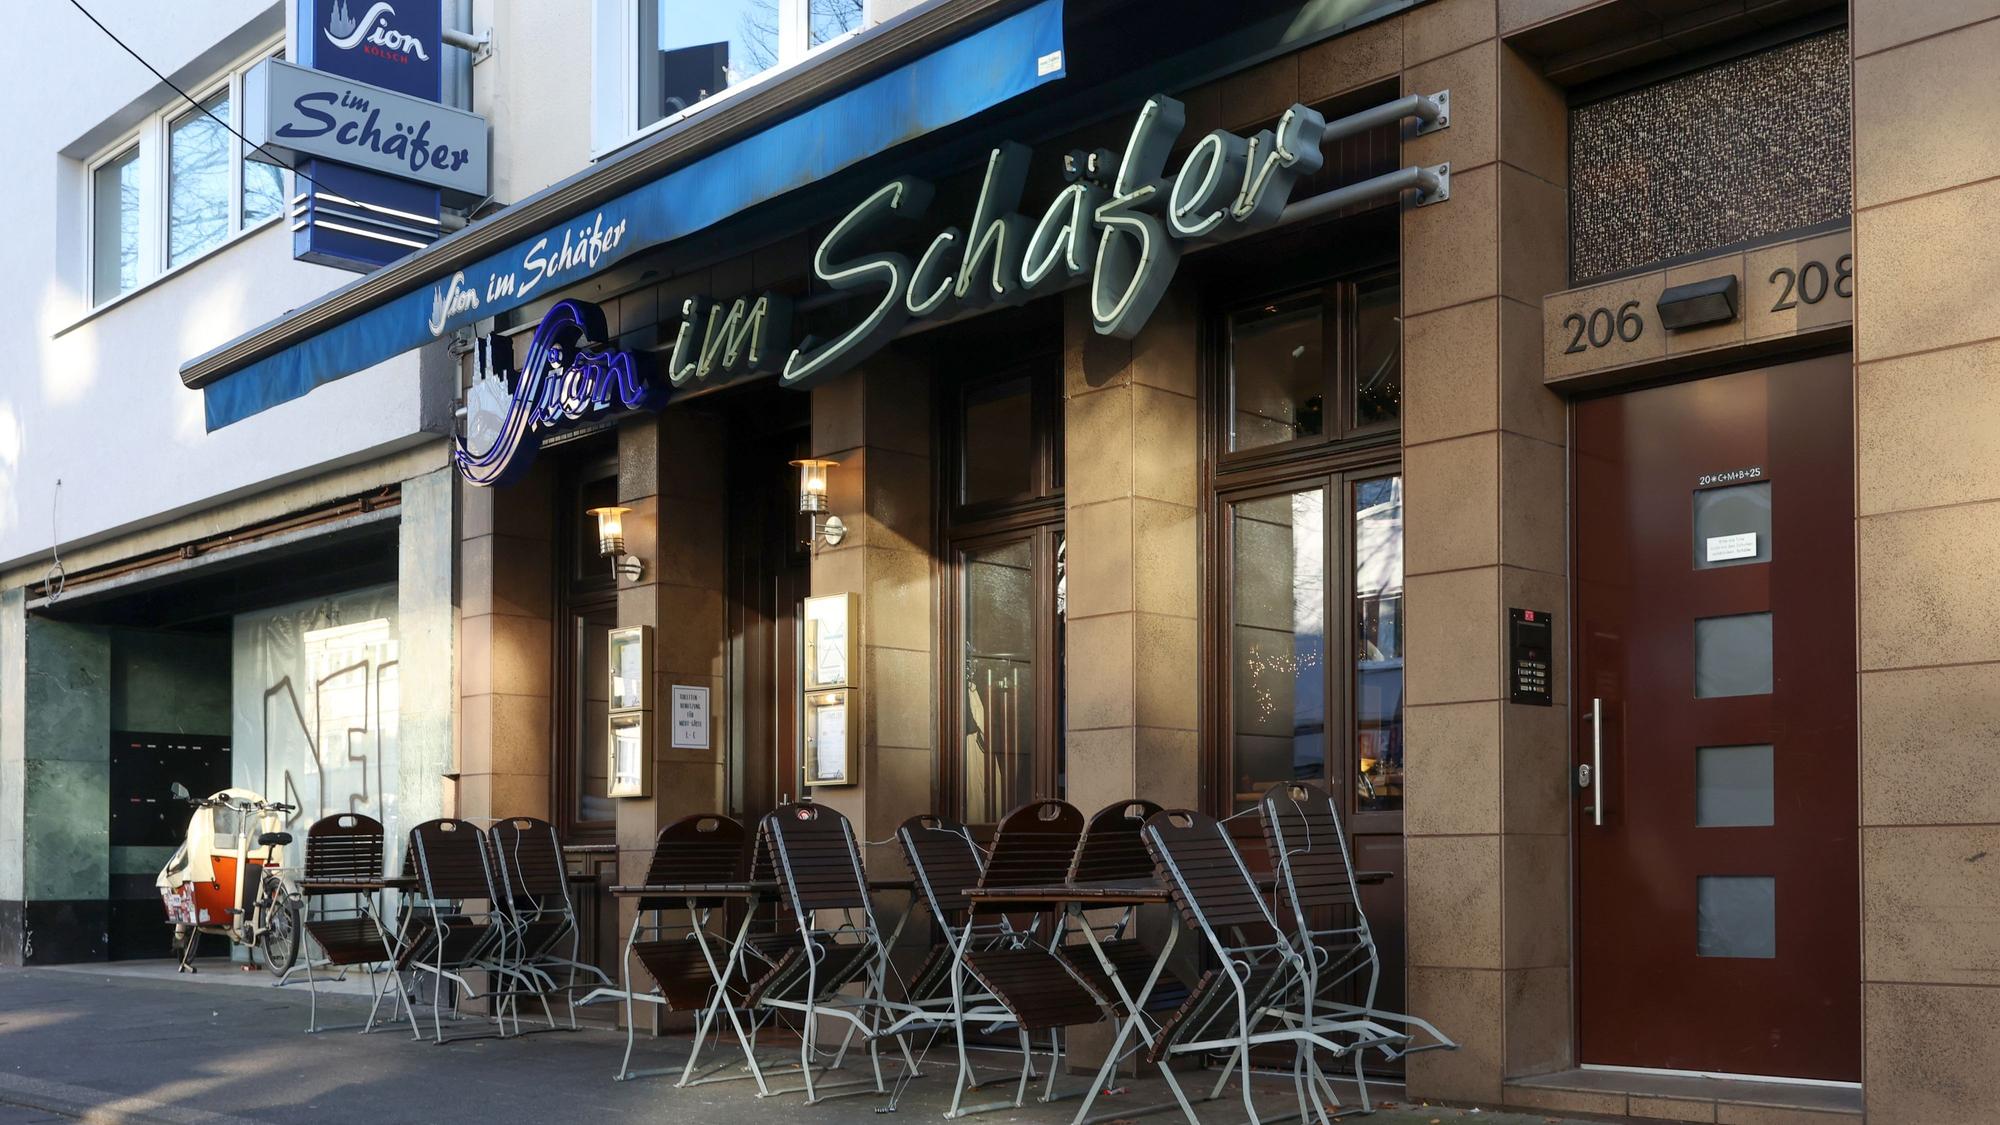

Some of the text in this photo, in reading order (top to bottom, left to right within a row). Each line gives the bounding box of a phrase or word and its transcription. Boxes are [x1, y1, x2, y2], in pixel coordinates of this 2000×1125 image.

[324, 2, 429, 61] Sion
[275, 91, 469, 172] im Schäfer
[428, 212, 626, 336] Sion im Schäfer
[669, 94, 1325, 388] im Schäfer
[1769, 253, 1853, 313] 208
[1563, 301, 1643, 354] 206
[455, 298, 650, 487] Sion
